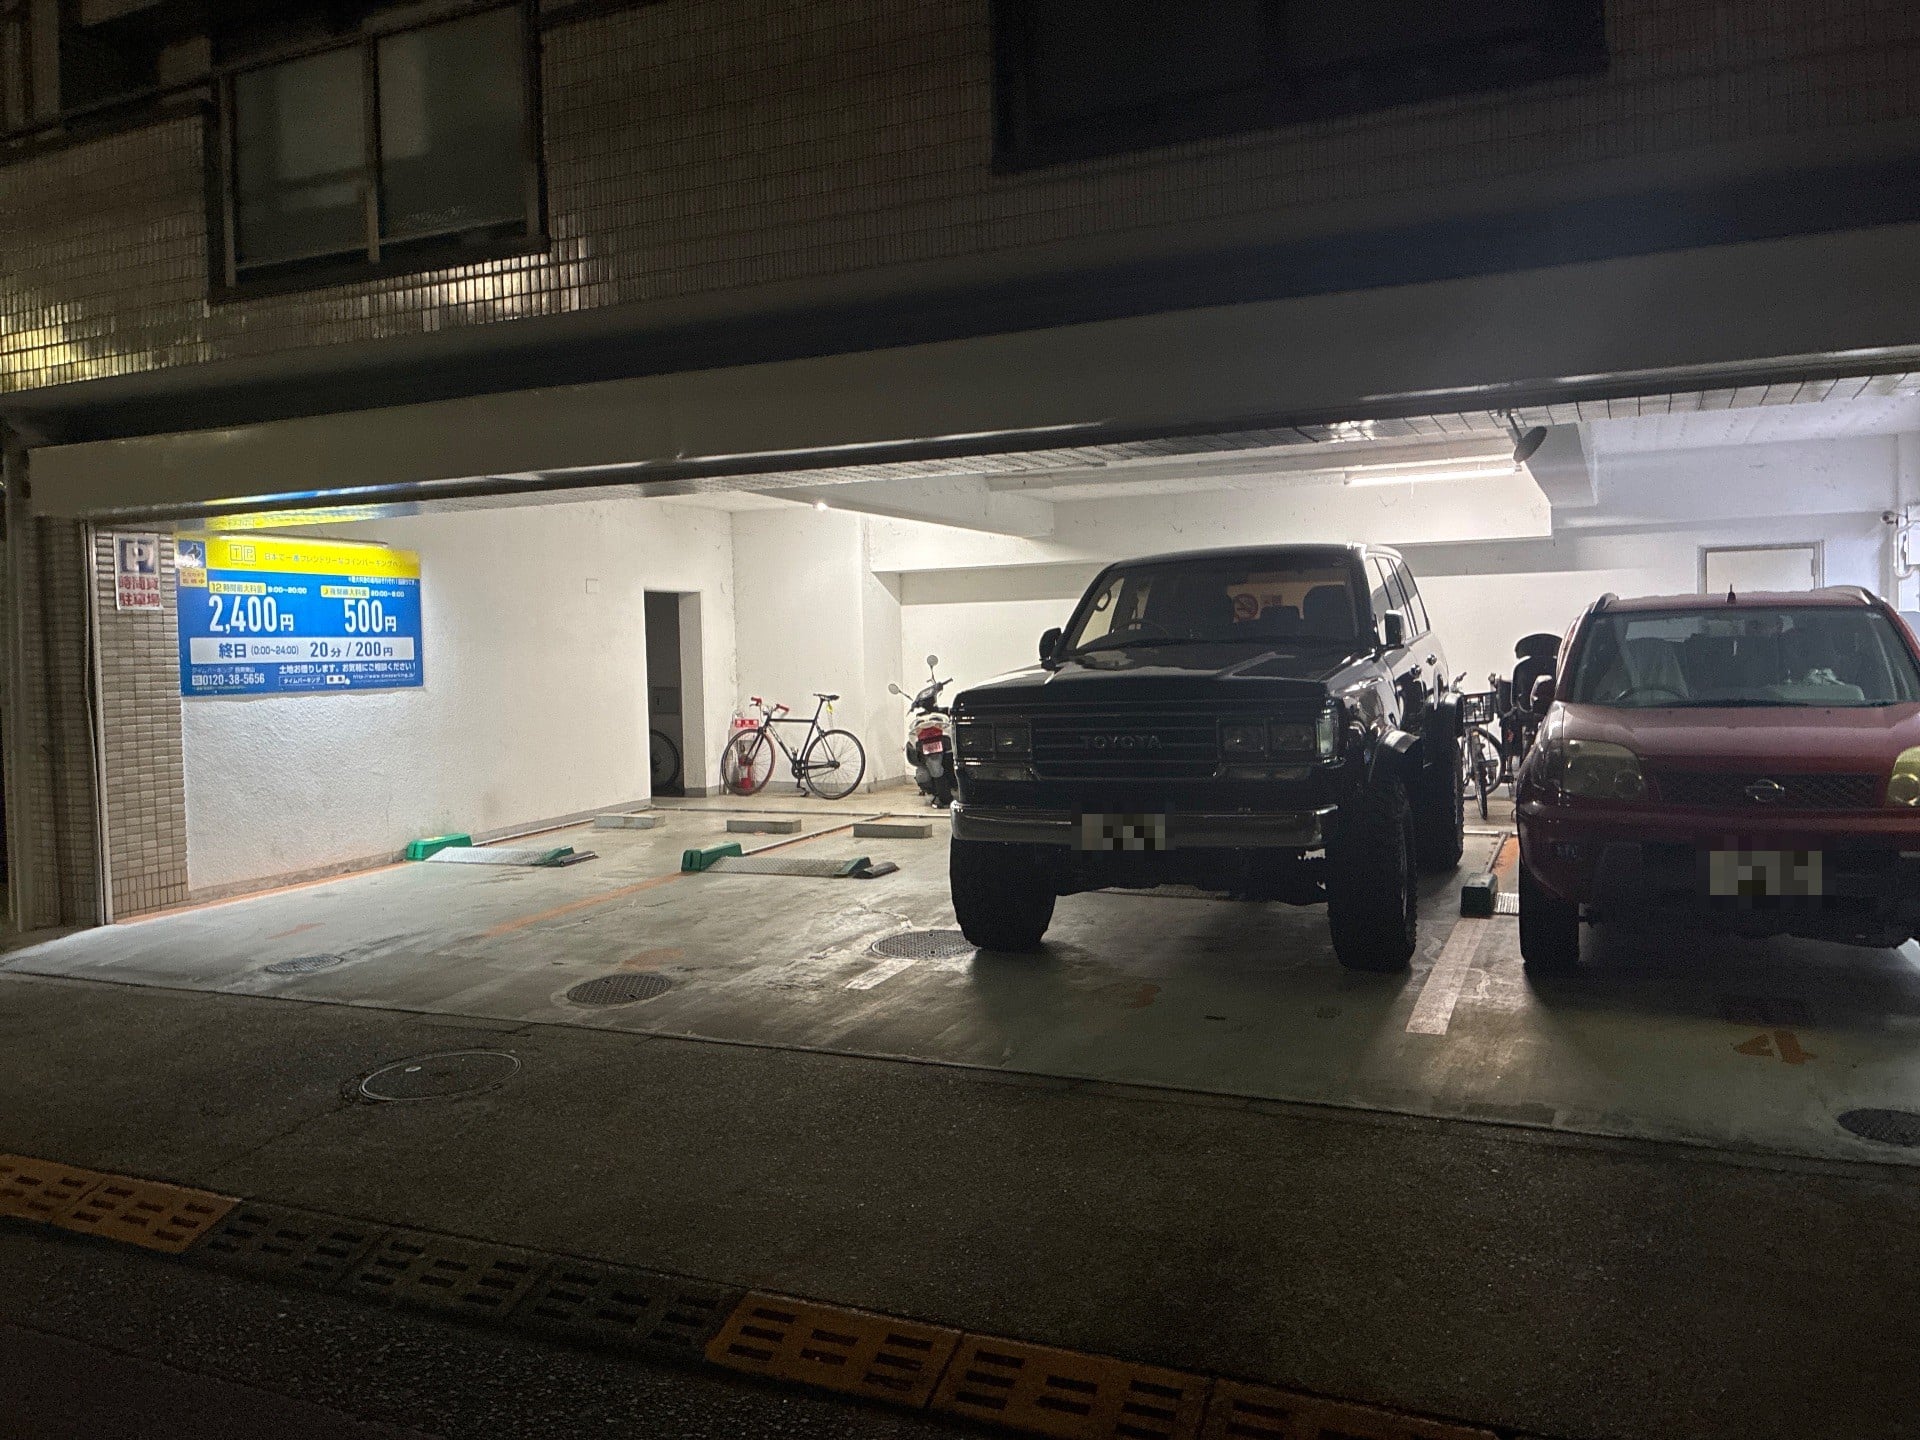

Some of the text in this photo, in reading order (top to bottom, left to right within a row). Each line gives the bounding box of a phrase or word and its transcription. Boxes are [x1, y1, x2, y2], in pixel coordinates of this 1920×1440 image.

[120, 576, 158, 590] 時間貸
[119, 593, 160, 606] 駐車場
[208, 595, 294, 634] 2,400円
[344, 599, 397, 633] 500円
[219, 643, 247, 659] 終日
[202, 673, 265, 686] 0120-38-5656
[1079, 734, 1165, 750] TOYOTA
